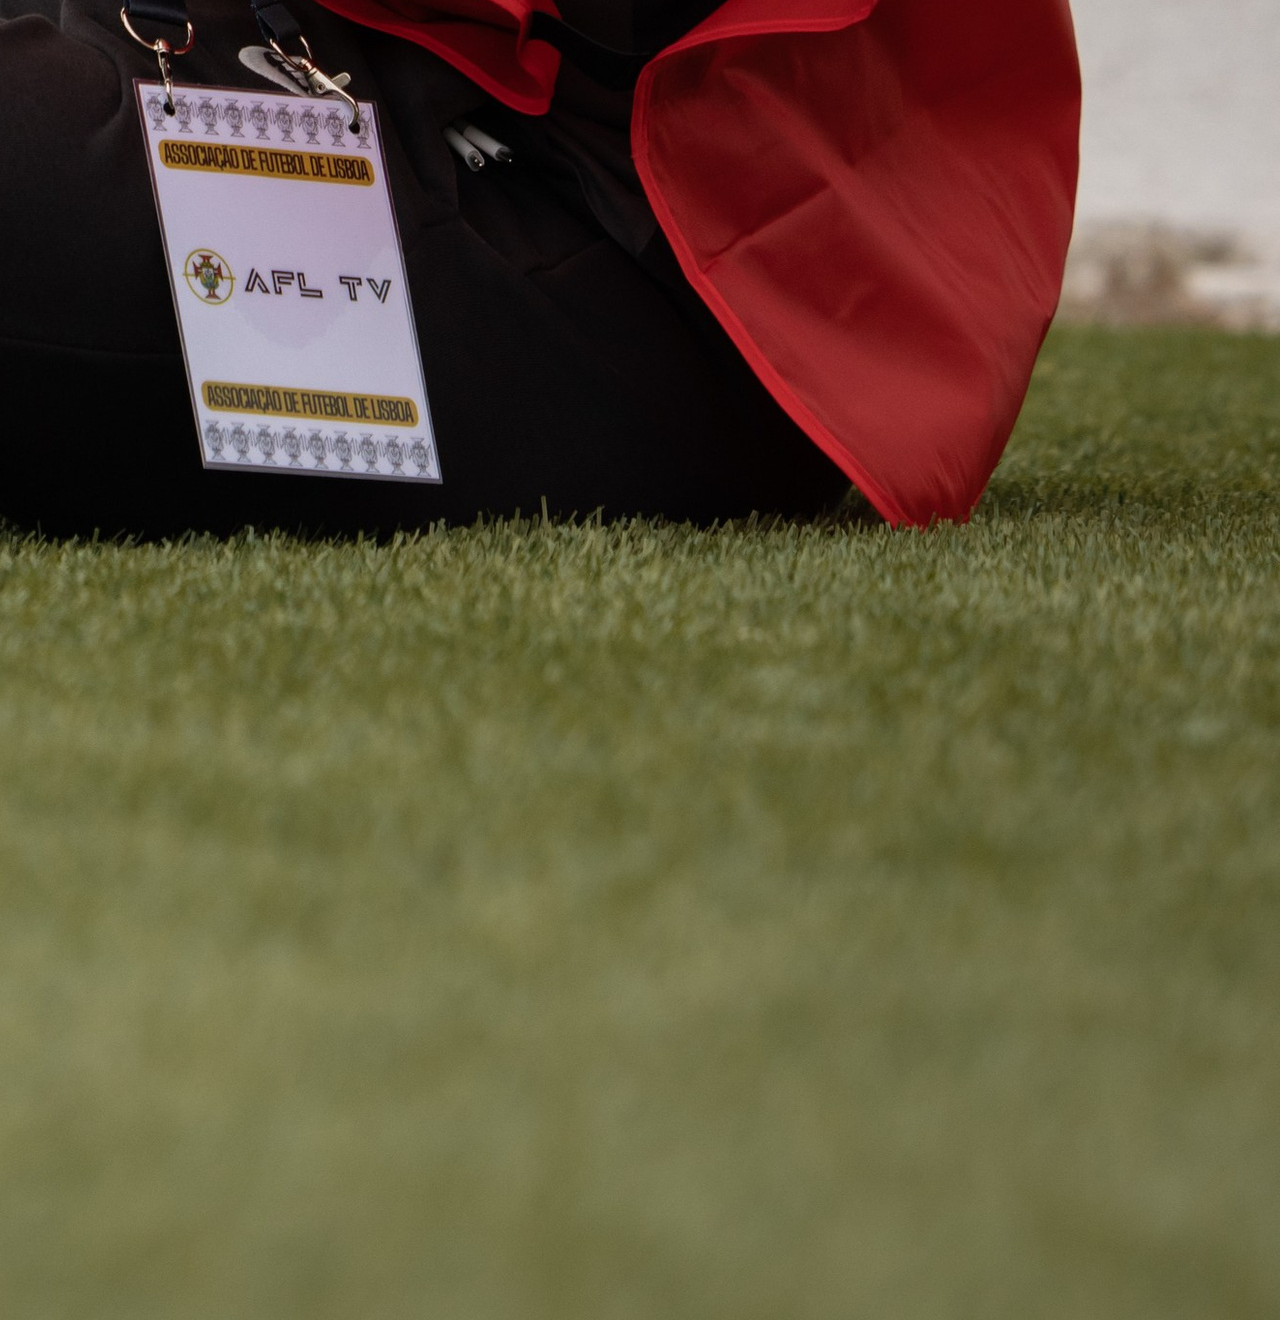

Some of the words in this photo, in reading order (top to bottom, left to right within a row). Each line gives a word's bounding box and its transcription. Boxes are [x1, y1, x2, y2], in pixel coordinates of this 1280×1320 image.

[163, 142, 239, 171] ASSOCIAÇÃO
[240, 148, 258, 171] DE
[258, 151, 310, 177] FUTEBOL
[309, 155, 327, 178] DE
[326, 157, 371, 182] LISBOA
[245, 267, 324, 299] AFL
[338, 275, 392, 304] TV
[206, 384, 282, 414] ASSOCIAÇÃO
[282, 390, 300, 414] DE
[301, 393, 353, 418] FUTEBOL
[353, 397, 371, 420] DE
[370, 398, 415, 424] LISBOA
